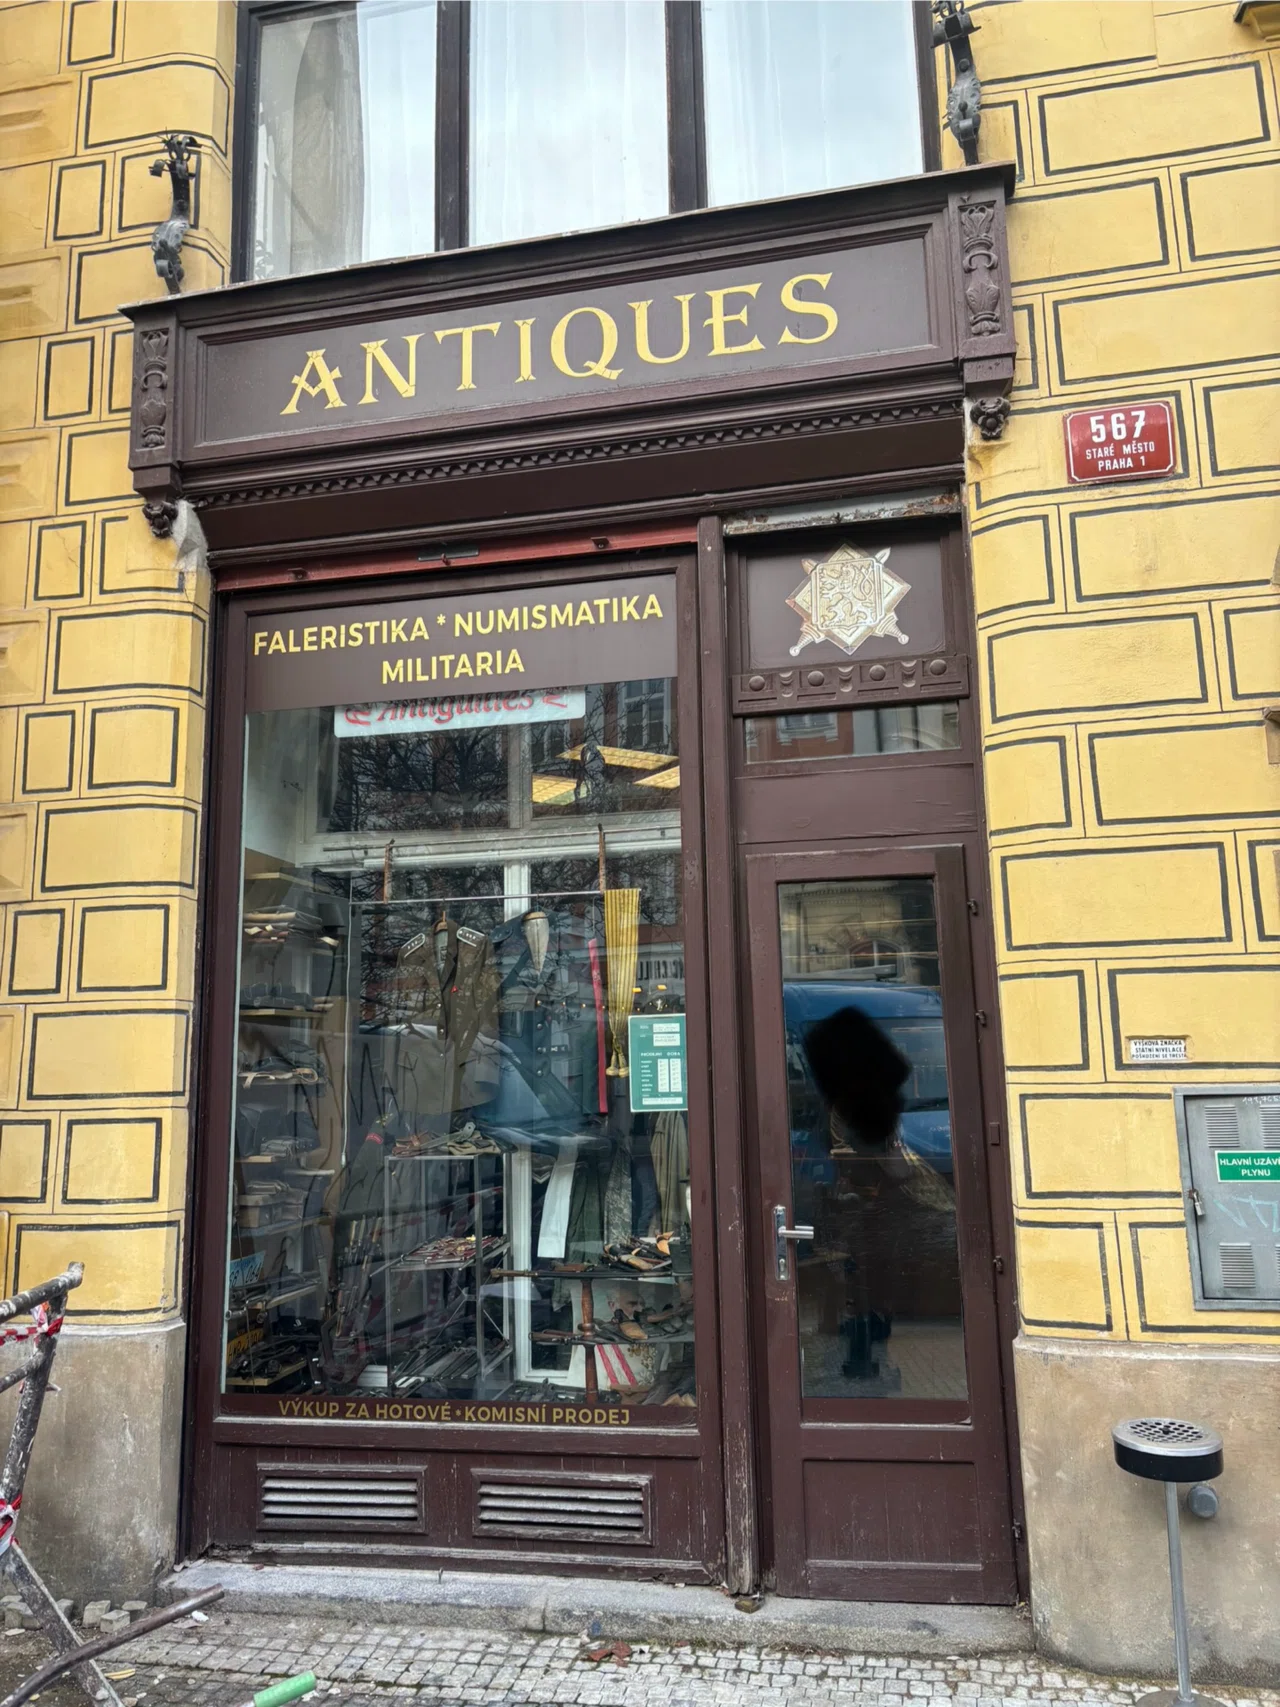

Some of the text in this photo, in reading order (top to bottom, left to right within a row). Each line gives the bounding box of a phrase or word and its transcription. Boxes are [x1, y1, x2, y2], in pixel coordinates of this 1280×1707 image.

[279, 272, 839, 415] ANTIQUES
[1090, 410, 1146, 443] 567
[1086, 441, 1155, 460] STARÉ MĚSTO
[1098, 456, 1146, 472] PRAHA 1
[253, 593, 664, 656] FALERISTIKA NUMISMATIKA
[381, 648, 526, 685] MILITARIA
[1220, 1156, 1252, 1166] HLAVNÍ
[1241, 1168, 1271, 1177] PLYNU
[278, 1398, 631, 1425] VÝKUP ZA HOTOVÉ KOMISNÍ PRODEJ
